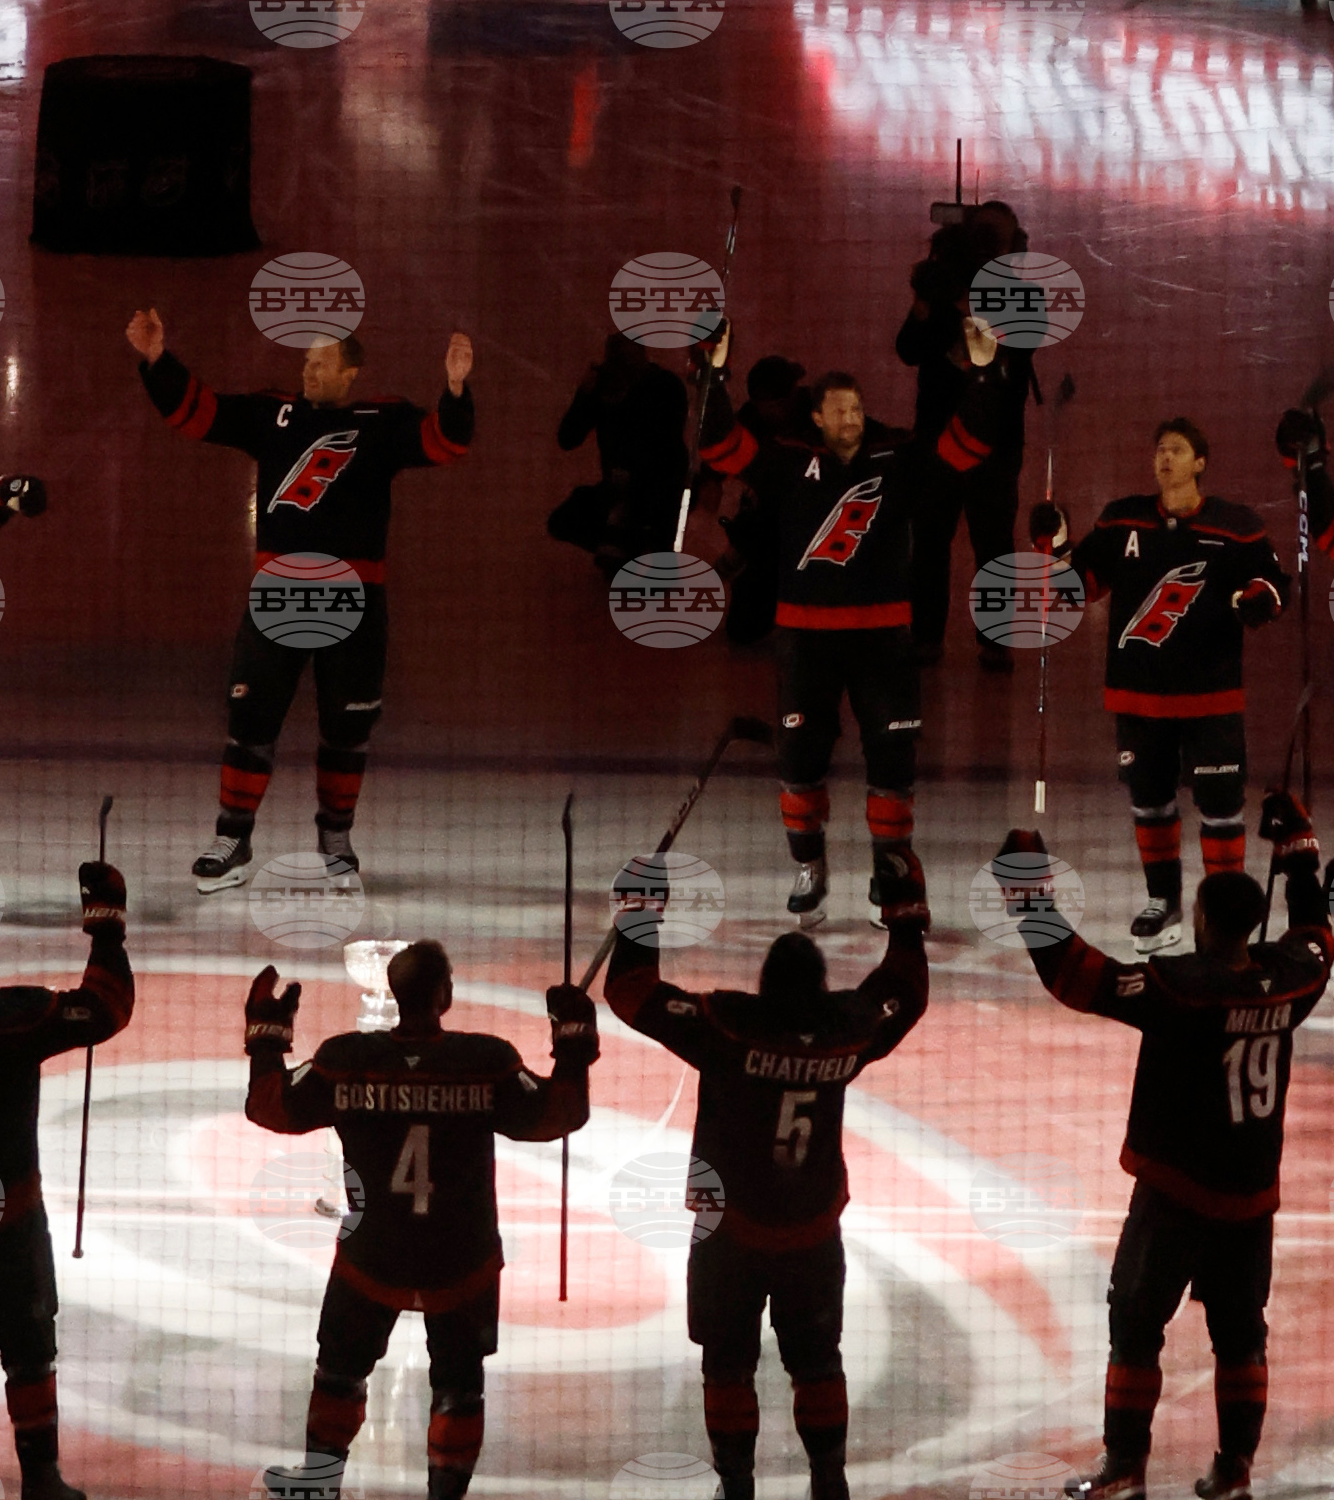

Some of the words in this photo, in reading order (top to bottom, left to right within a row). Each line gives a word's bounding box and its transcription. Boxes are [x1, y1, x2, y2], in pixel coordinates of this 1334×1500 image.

[276, 403, 294, 428] C
[804, 456, 821, 481] A
[1124, 530, 1140, 558] A
[1225, 1003, 1293, 1035] MILLER
[745, 1049, 858, 1084] CHATFIELD
[1222, 1034, 1281, 1124] 19
[334, 1081, 495, 1113] GOSTISBEHERE
[773, 1090, 818, 1170] 5
[390, 1124, 434, 1215] 4
